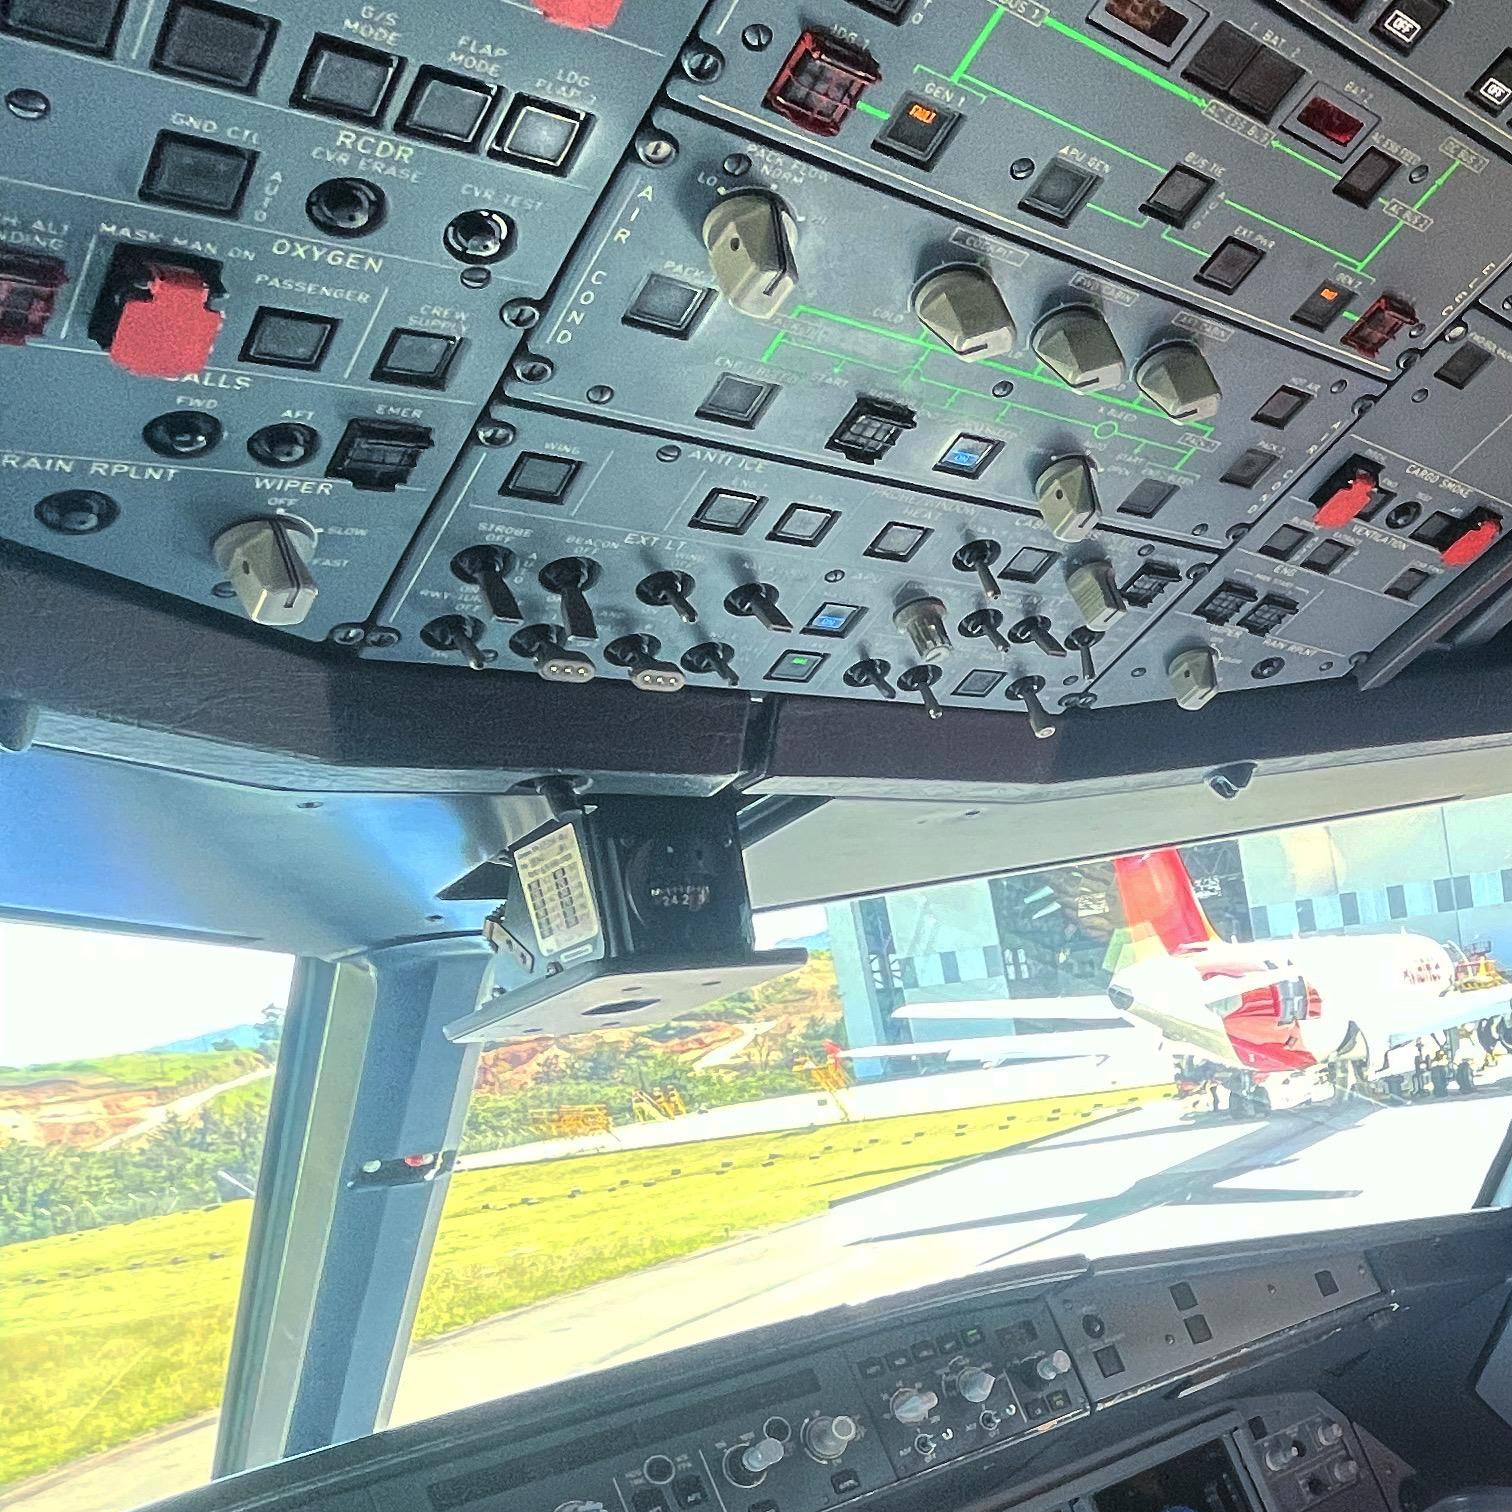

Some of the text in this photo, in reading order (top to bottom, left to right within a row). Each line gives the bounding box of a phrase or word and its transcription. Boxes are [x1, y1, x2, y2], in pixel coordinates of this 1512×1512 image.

[361, 5, 399, 27] G/S
[1392, 14, 1414, 35] OFF
[343, 18, 401, 47] MODE
[1262, 29, 1287, 49] BAT
[458, 35, 509, 57] FLAP
[449, 51, 501, 78] MODE
[557, 68, 591, 88] LDG
[924, 82, 953, 103] GEN
[1345, 83, 1362, 98] BAT
[1487, 82, 1505, 99] OFF
[171, 112, 218, 134] GND
[336, 130, 414, 164] RCDR
[311, 146, 428, 185] CVR ERASE
[1058, 144, 1112, 174] APU GEN
[1184, 151, 1210, 169] BUS
[696, 172, 718, 187] LO
[760, 164, 805, 186] NORM
[460, 182, 498, 200] CVR
[613, 184, 655, 245] AIR
[31, 219, 71, 236] ALT
[1233, 225, 1254, 240] EXT
[100, 221, 257, 262] MASK MAN ON
[271, 238, 384, 273] OXYGEN
[254, 273, 371, 305] PASSENGER
[419, 303, 470, 321] CREW
[555, 269, 609, 345] COND
[871, 306, 905, 324] COLD
[406, 314, 470, 334] SUPPLY
[165, 371, 254, 391] ALLS
[176, 395, 219, 412] FWD
[375, 404, 424, 419] EMER
[281, 408, 317, 422] AFT
[544, 441, 586, 456] WING
[0, 453, 180, 483] RAIN RPLNT
[687, 449, 768, 475] ANTI ICE
[1405, 463, 1439, 485] CARGO
[253, 476, 335, 497] WIPER
[267, 497, 299, 508] OFF
[903, 507, 942, 522] HEAT
[327, 524, 370, 538] SLOW
[477, 522, 535, 539] STROBE
[485, 533, 511, 544] OFF
[564, 535, 621, 550] BEACON
[623, 532, 688, 552] EXT LT
[312, 557, 351, 570] FAST
[1274, 564, 1296, 579] ENG
